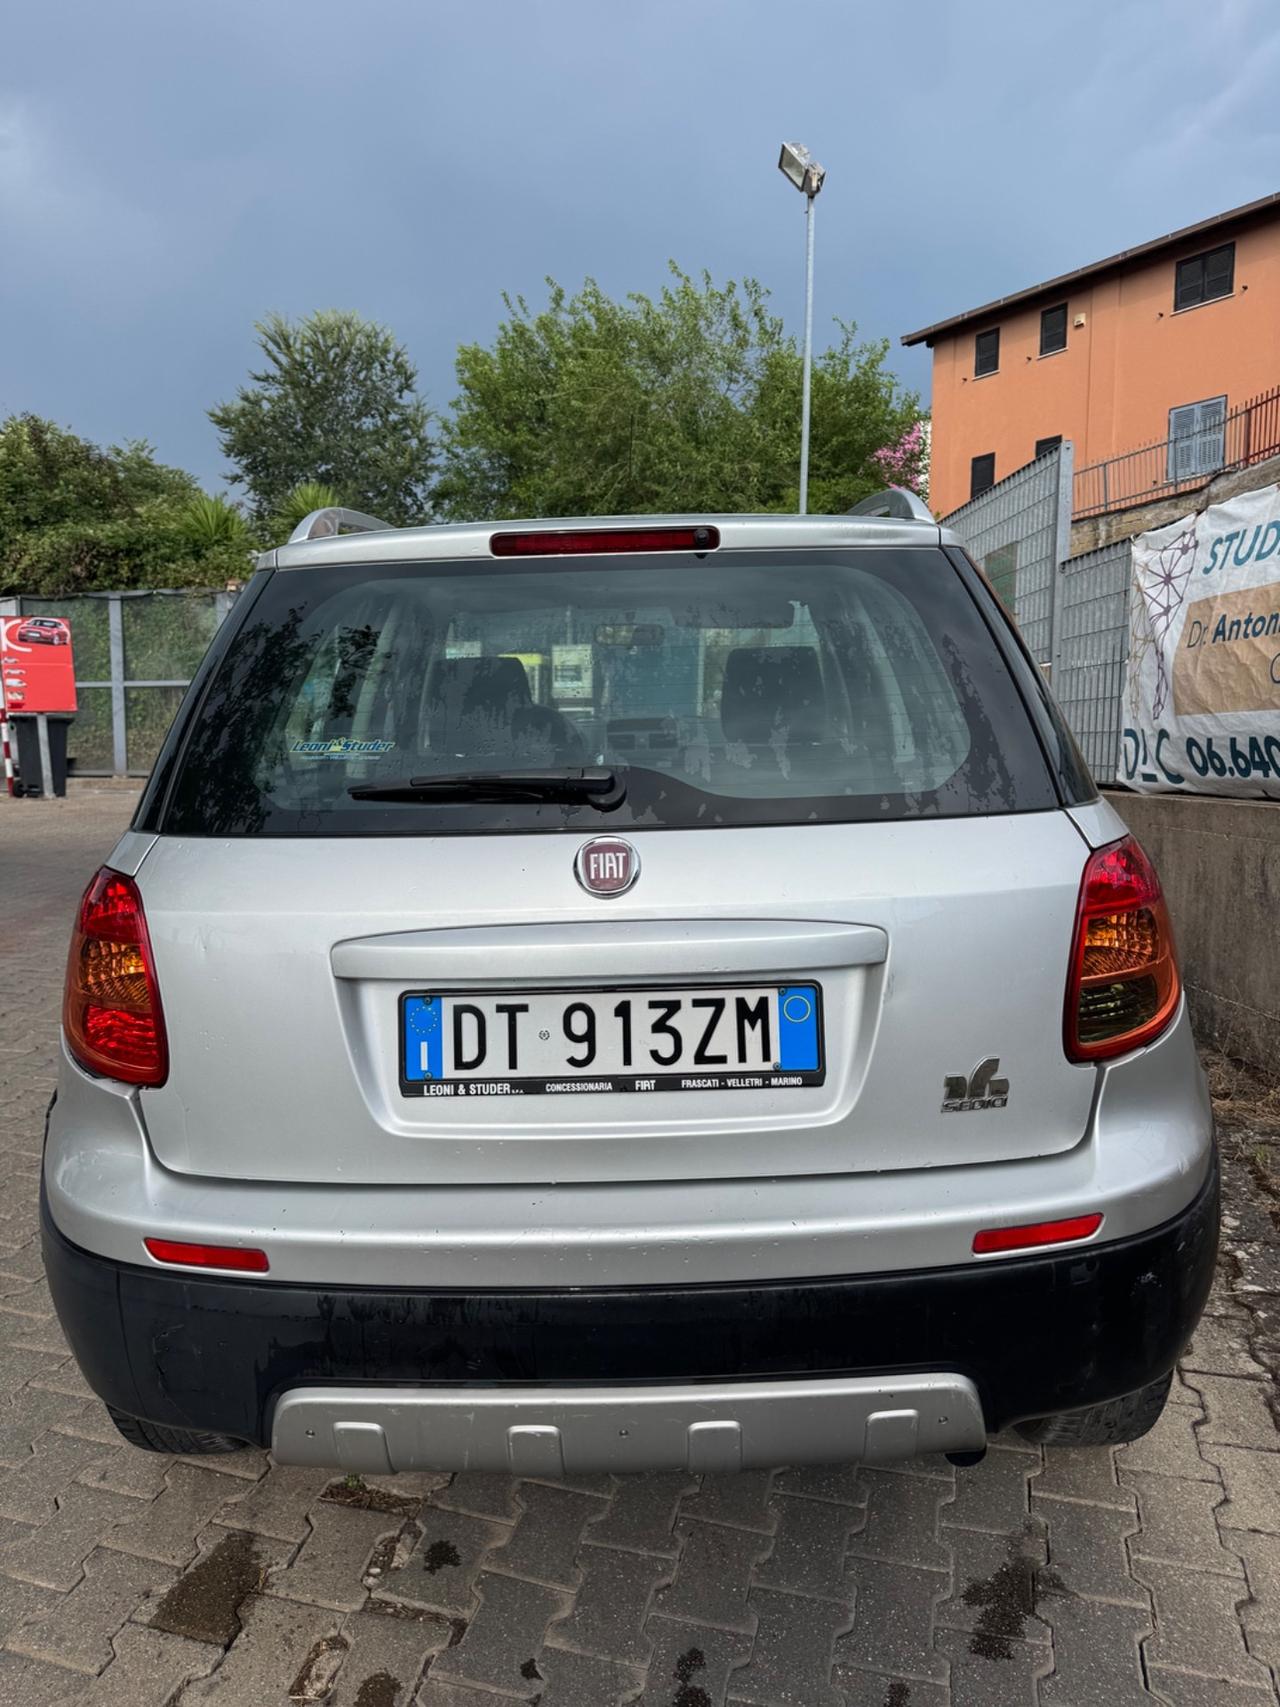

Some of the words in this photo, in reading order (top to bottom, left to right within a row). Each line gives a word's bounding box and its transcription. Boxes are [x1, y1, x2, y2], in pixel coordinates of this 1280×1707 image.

[1203, 519, 1280, 576] STUD
[1188, 621, 1208, 648] Dr.
[1212, 612, 1280, 644] Anton
[290, 740, 333, 752] Leoni
[341, 739, 395, 752] Studer
[589, 852, 626, 880] FIAT
[453, 1004, 530, 1071] DT
[562, 996, 771, 1068] 913ZM
[423, 1085, 455, 1096] LEONI
[457, 1084, 466, 1095] &
[469, 1083, 511, 1095] STUDER
[545, 1082, 614, 1093] CONCESSIONARIA
[635, 1080, 656, 1091] FIAT
[681, 1079, 720, 1088] FRASCATI
[727, 1077, 763, 1087] VELLETRI
[771, 1076, 803, 1086] MARINO
[941, 1096, 1008, 1113] SEDICI
